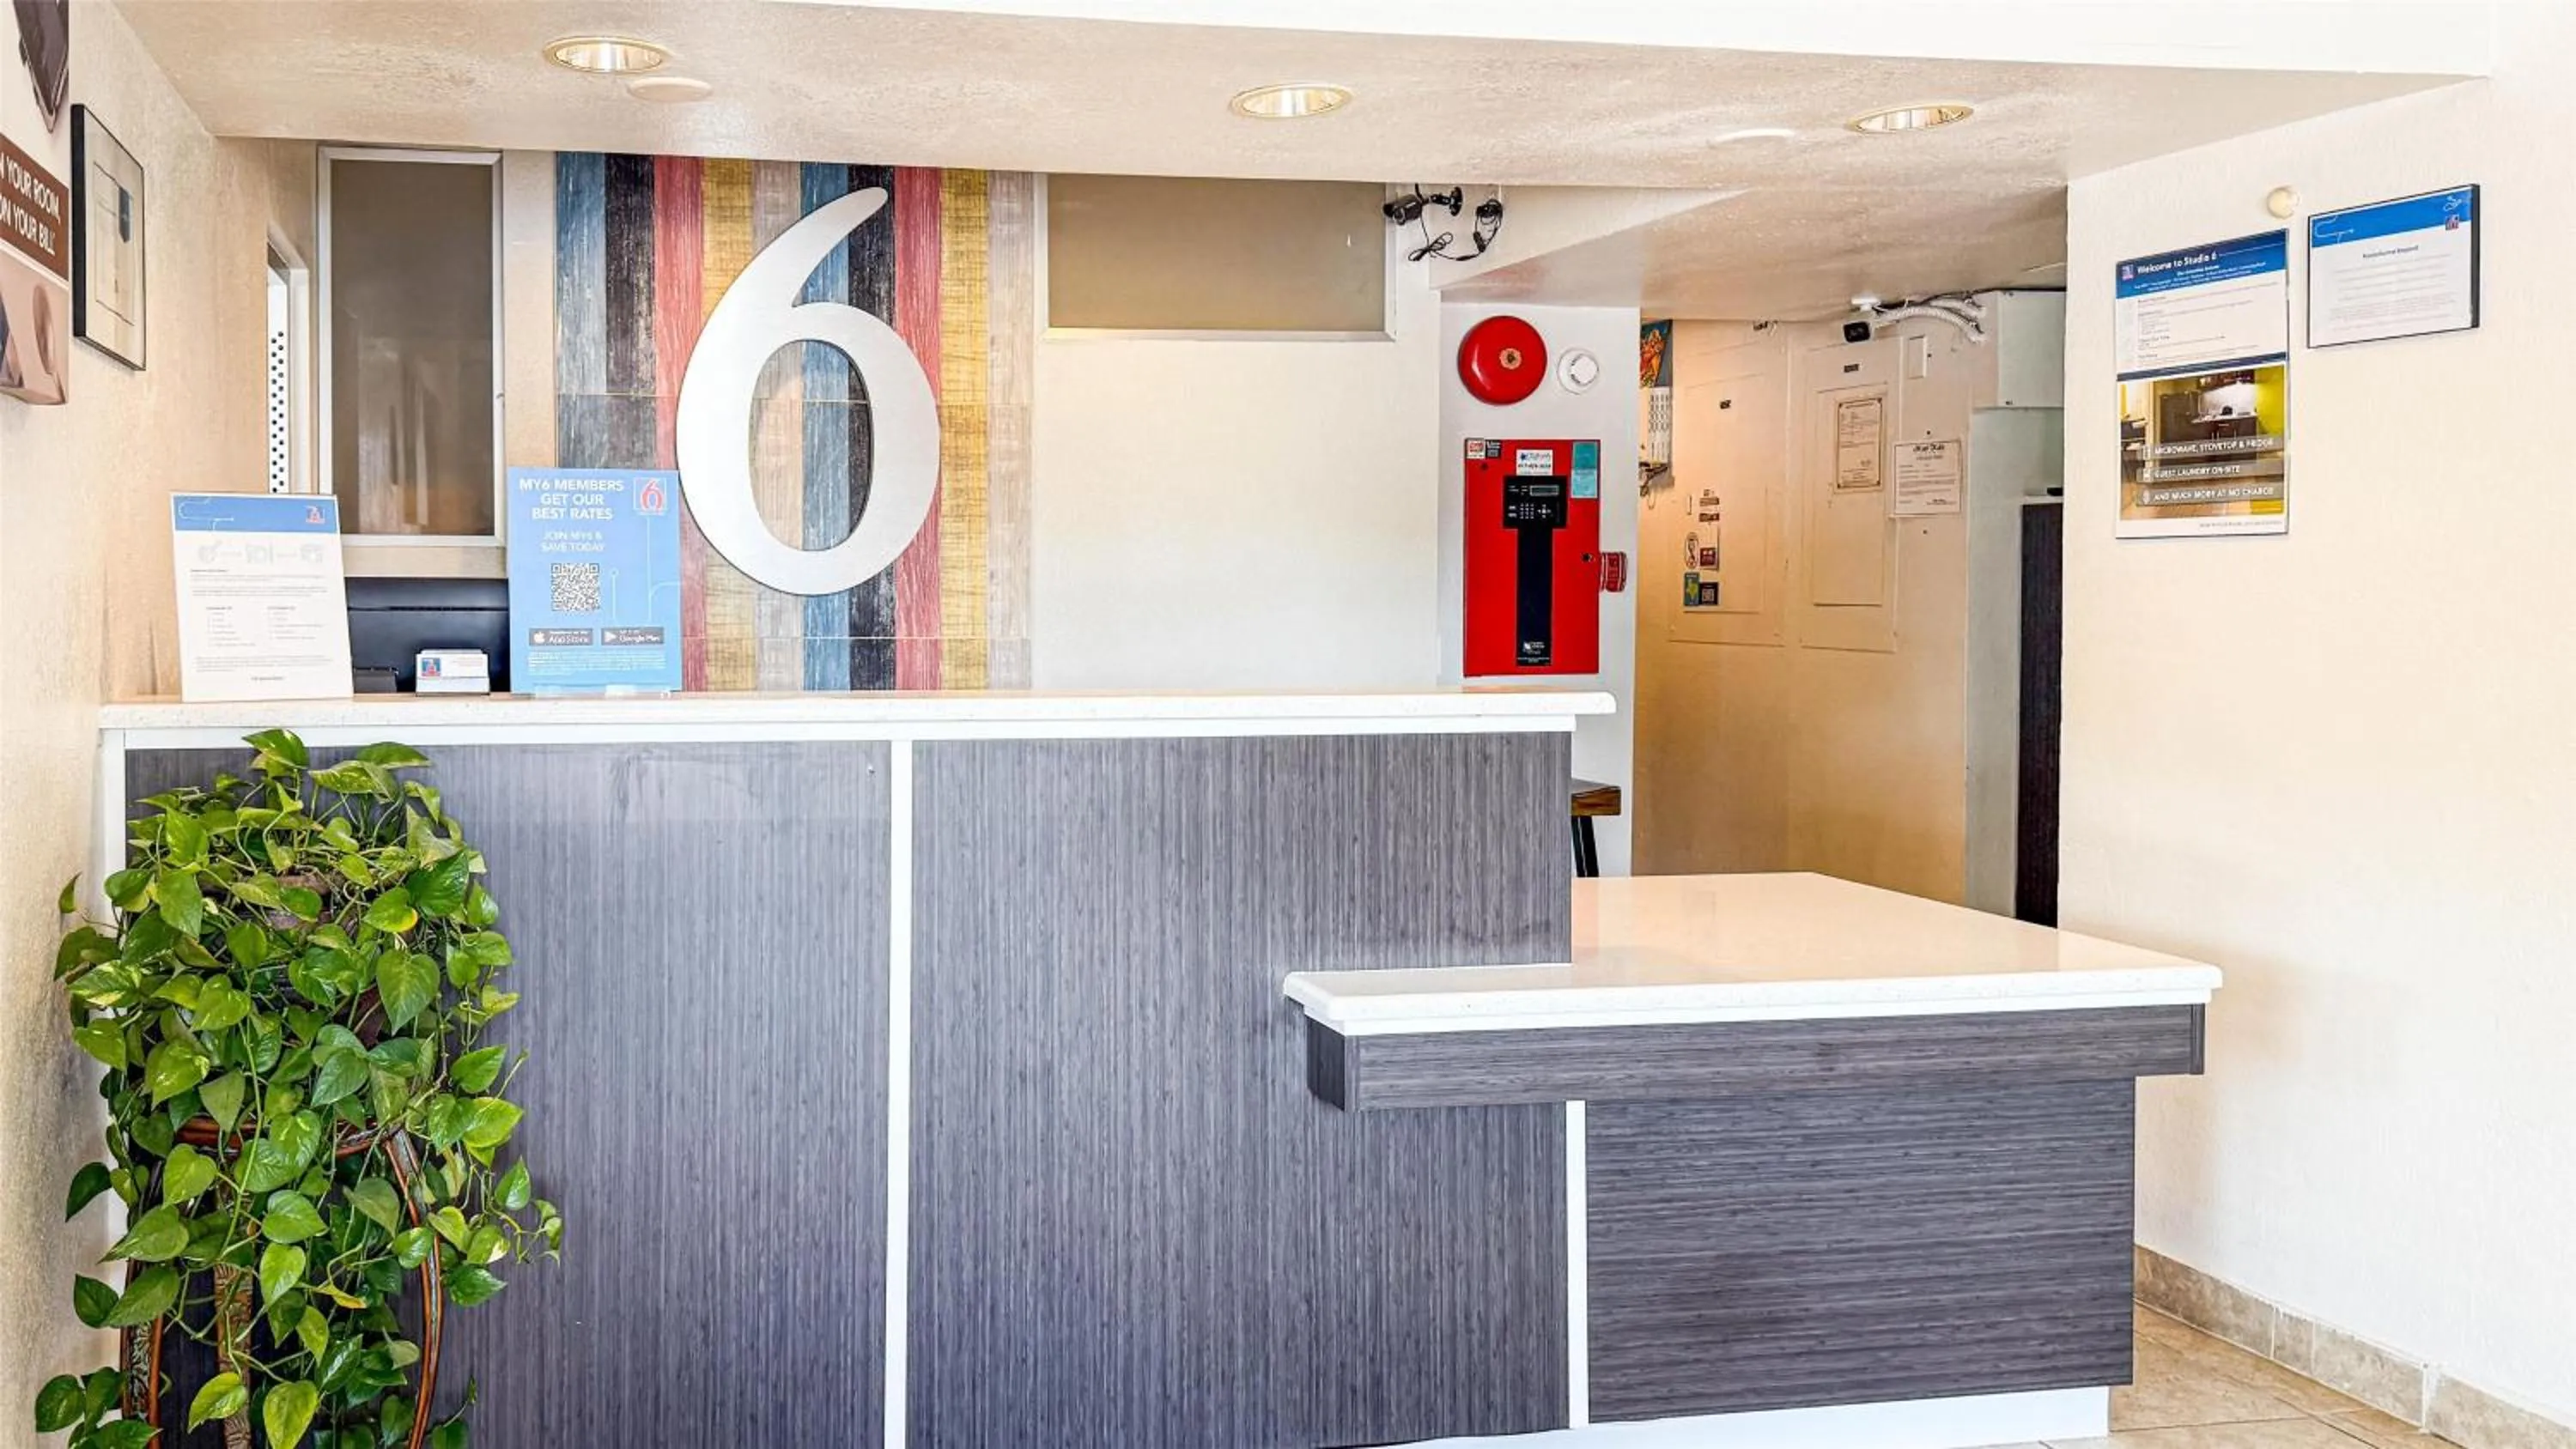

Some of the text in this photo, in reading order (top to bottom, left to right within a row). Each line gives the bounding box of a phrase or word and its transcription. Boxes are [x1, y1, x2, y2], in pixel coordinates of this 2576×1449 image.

[7, 155, 32, 200] YOUR
[13, 203, 37, 244] YOUR
[2136, 261, 2172, 274] Welcome
[2184, 253, 2209, 266] Studio
[676, 186, 941, 597] 6
[519, 478, 624, 492] MY6 MEMBERS
[540, 494, 605, 506] GET OUR
[2154, 492, 2170, 501] AND
[532, 507, 613, 521] BEST RATES
